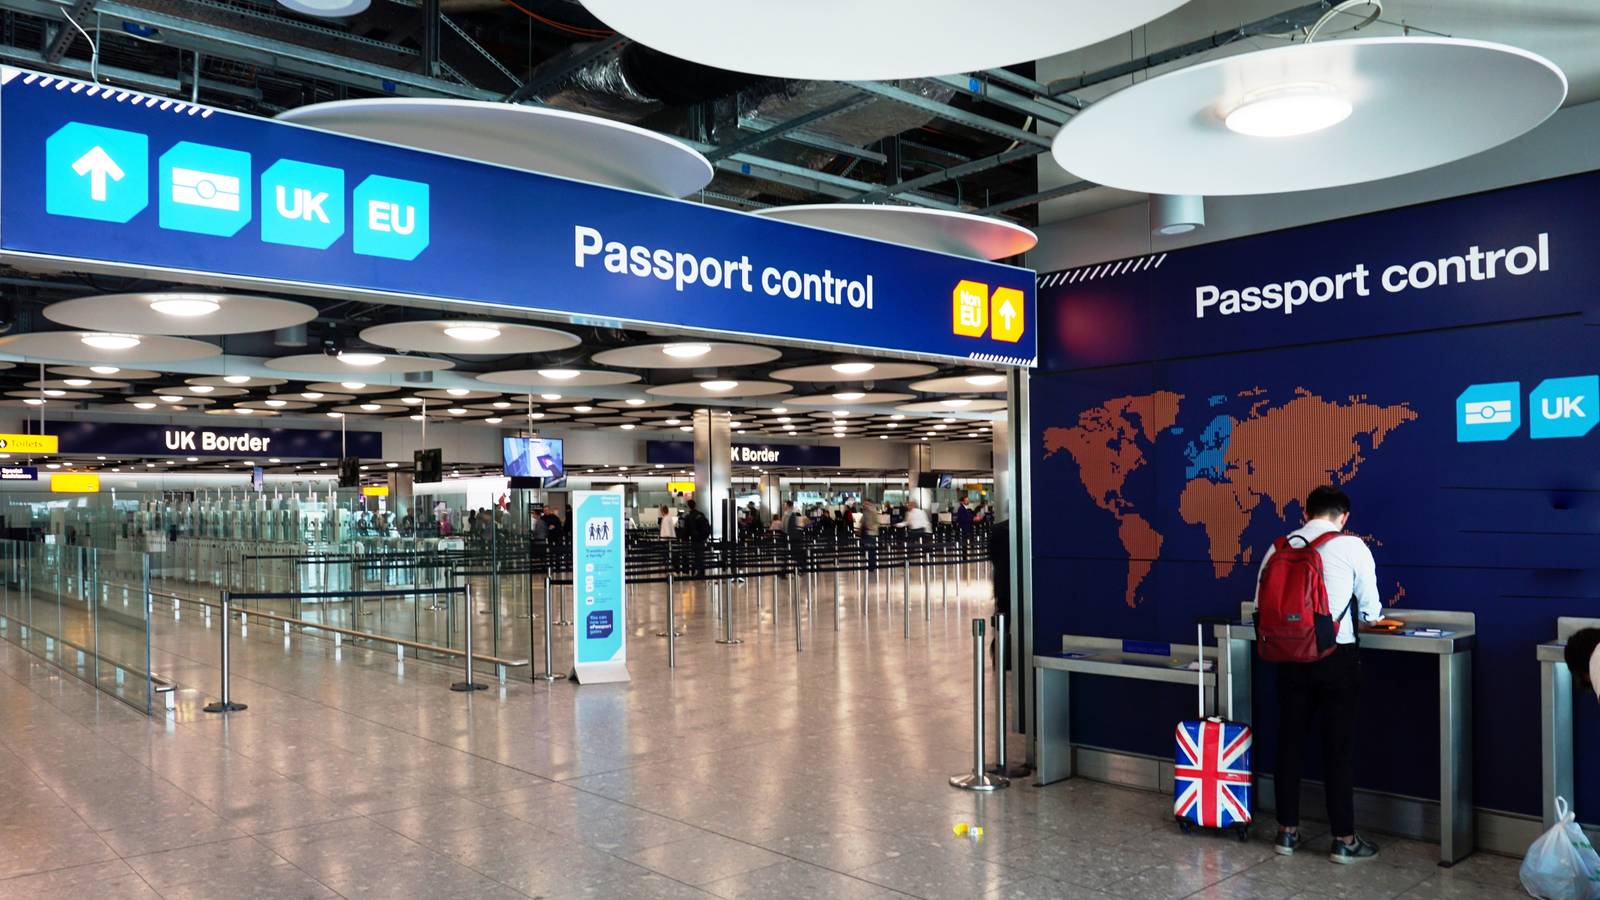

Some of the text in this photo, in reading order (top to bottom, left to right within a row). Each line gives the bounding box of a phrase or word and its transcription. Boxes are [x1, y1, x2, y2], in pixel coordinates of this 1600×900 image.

[276, 184, 331, 224] UK
[368, 199, 416, 236] EU
[574, 225, 874, 310] Passport control
[1195, 232, 1550, 319] Passport control
[960, 290, 981, 308] Non
[960, 304, 981, 328] EU
[1541, 395, 1587, 420] UK
[165, 430, 271, 452] UK Border
[731, 447, 779, 463] K Border
